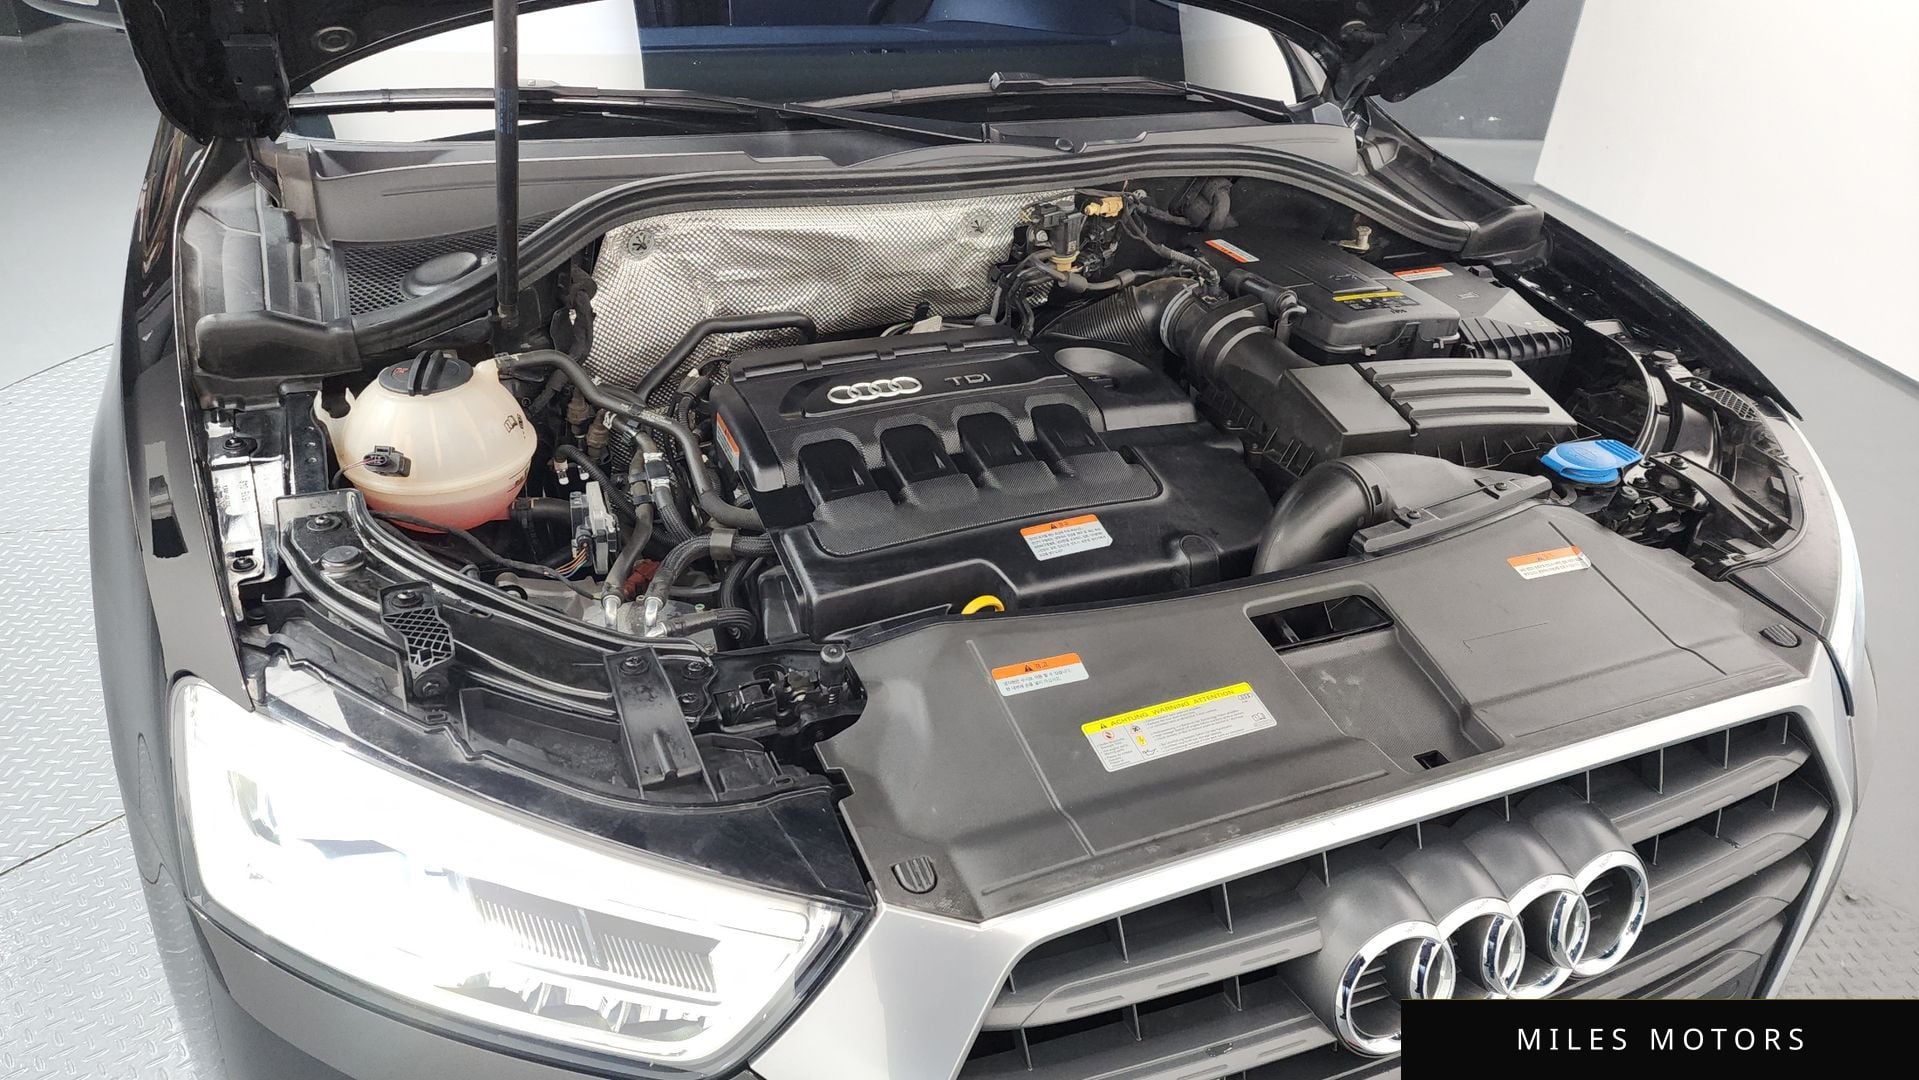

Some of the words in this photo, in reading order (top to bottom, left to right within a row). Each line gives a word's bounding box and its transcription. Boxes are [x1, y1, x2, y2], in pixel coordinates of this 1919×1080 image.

[944, 373, 991, 386] TDI
[1110, 712, 1149, 726] ACHTUNG
[1152, 701, 1190, 715] WARNING
[1193, 690, 1234, 704] ATTENTION
